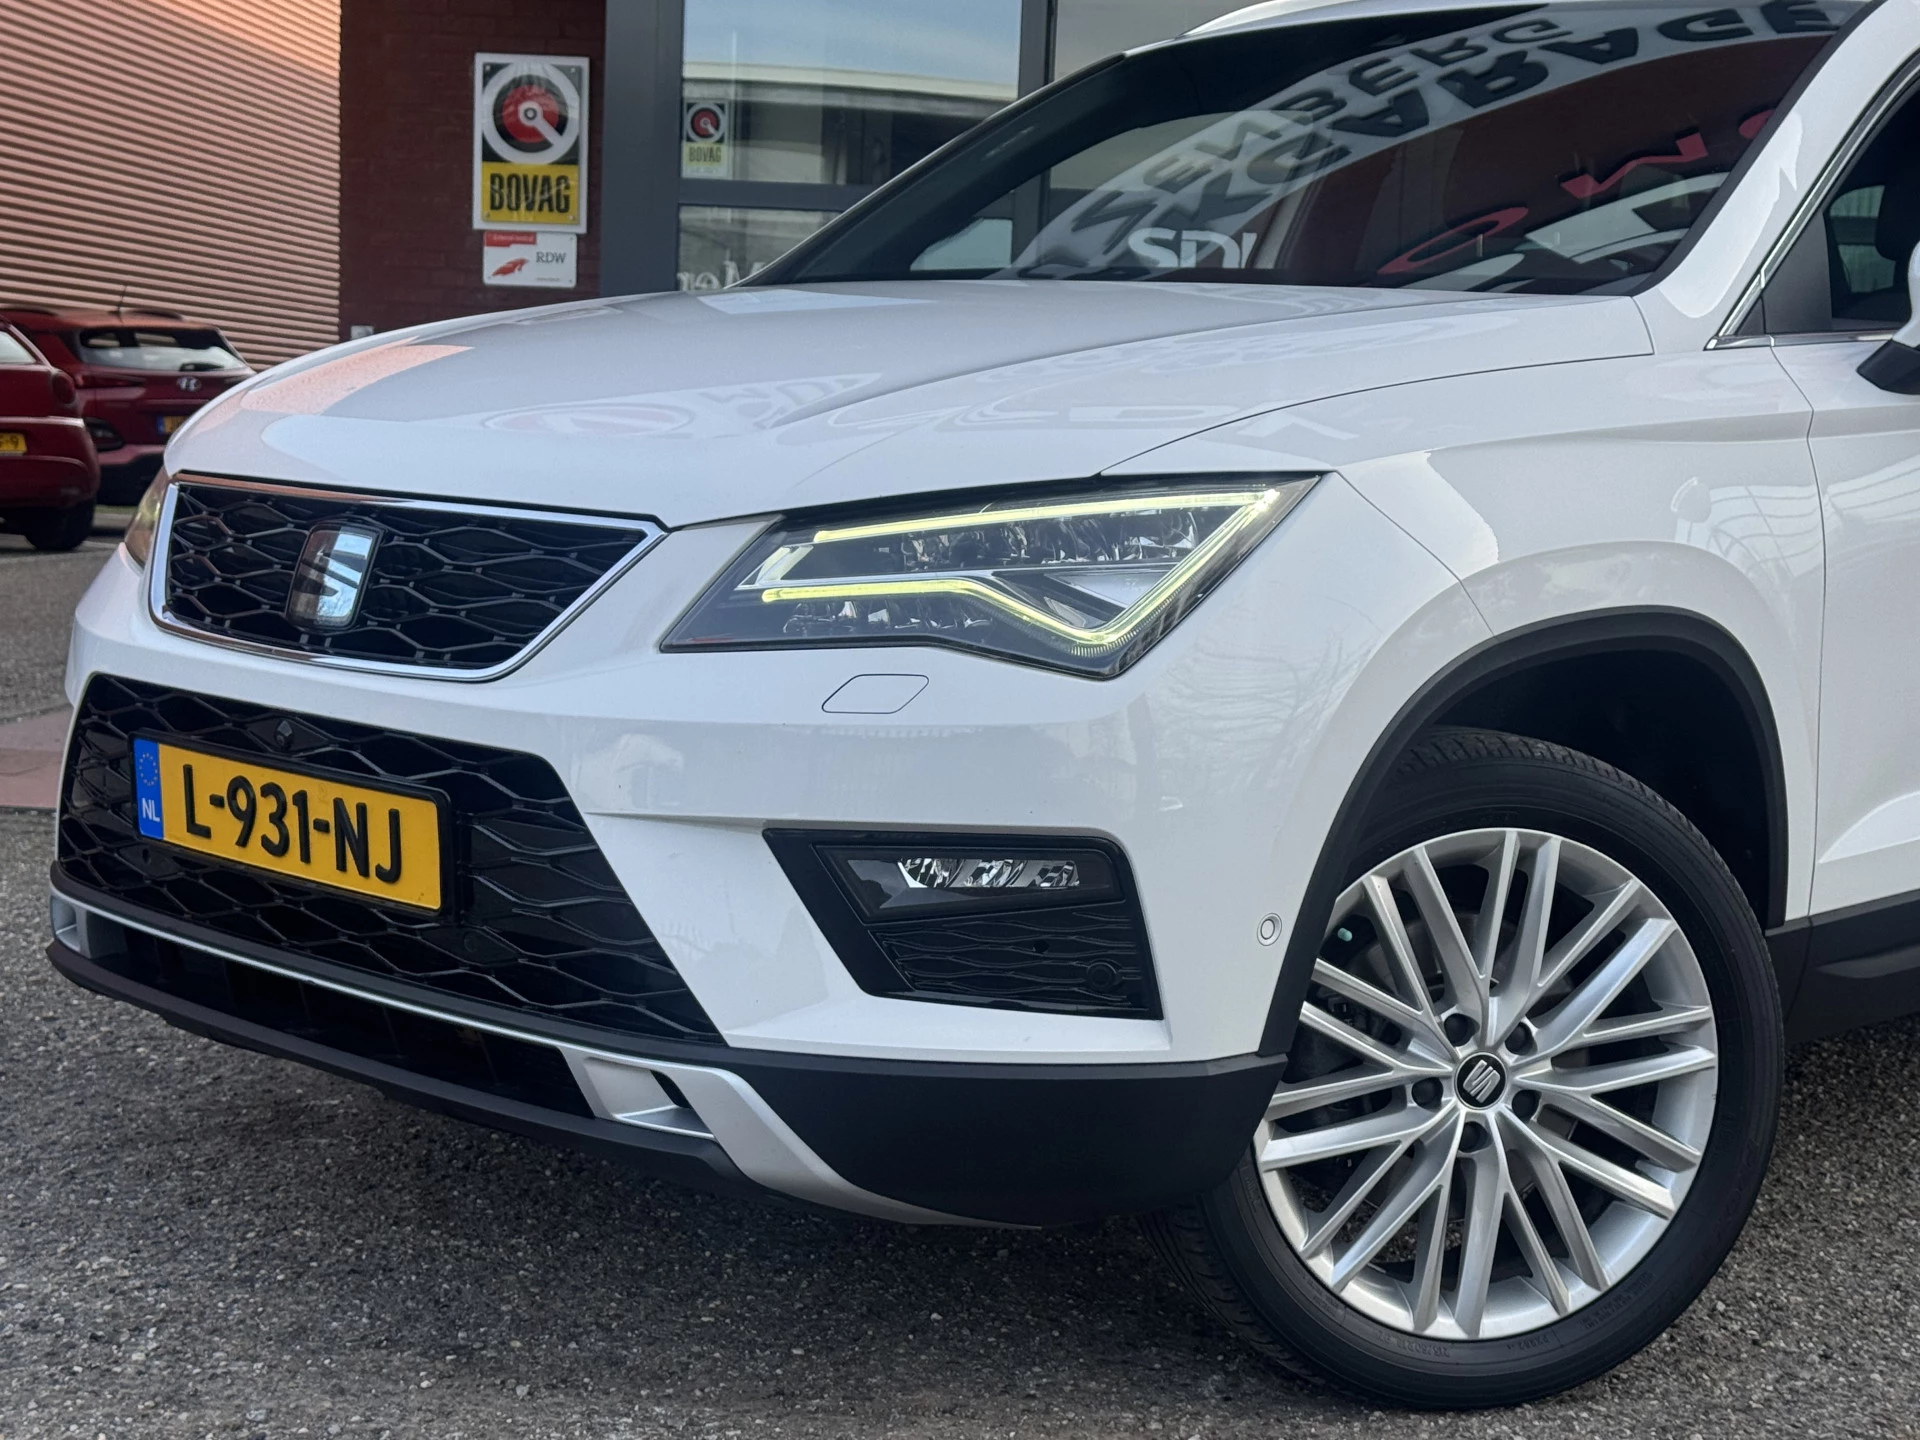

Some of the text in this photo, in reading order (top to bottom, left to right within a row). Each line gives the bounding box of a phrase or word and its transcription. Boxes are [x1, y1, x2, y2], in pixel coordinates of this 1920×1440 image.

[689, 146, 722, 163] BOVAG
[489, 173, 571, 214] BOVAG
[536, 251, 567, 264] RDW
[141, 763, 402, 884] NL L-931-NJ
